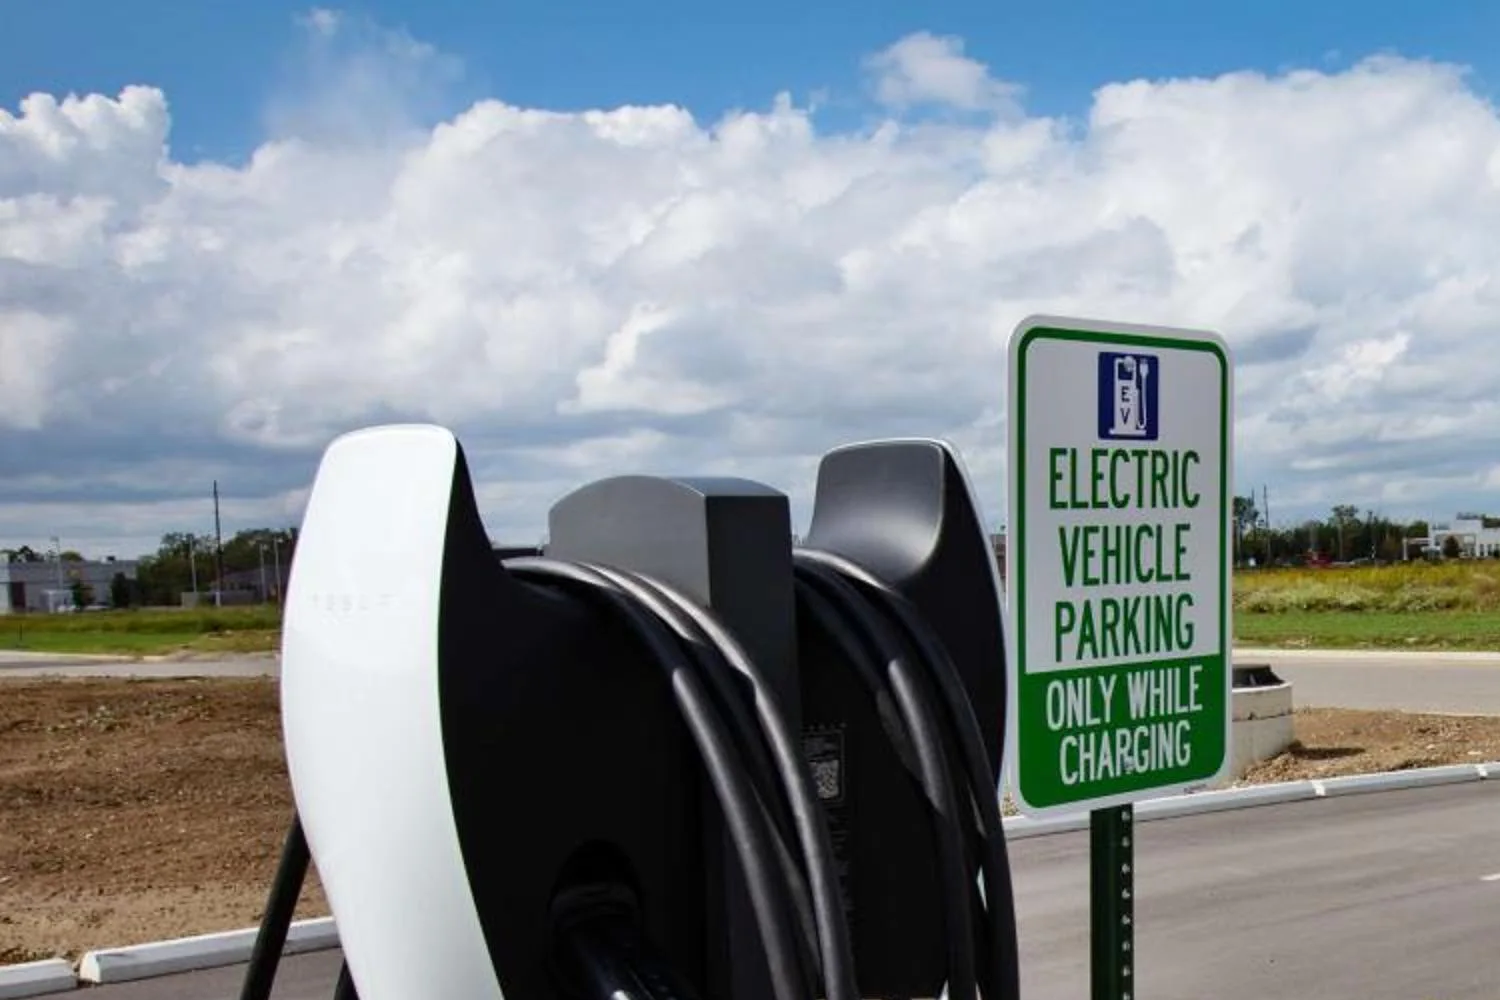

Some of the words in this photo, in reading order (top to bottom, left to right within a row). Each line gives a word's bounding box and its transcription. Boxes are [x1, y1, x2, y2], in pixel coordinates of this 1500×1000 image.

[1049, 447, 1201, 510] ELECTRIC
[1059, 523, 1191, 588] VEHICLE
[1055, 593, 1194, 663] PARKING
[1046, 674, 1118, 732] ONLY
[1126, 664, 1204, 720] WHILE
[1060, 721, 1191, 786] CHARGING
